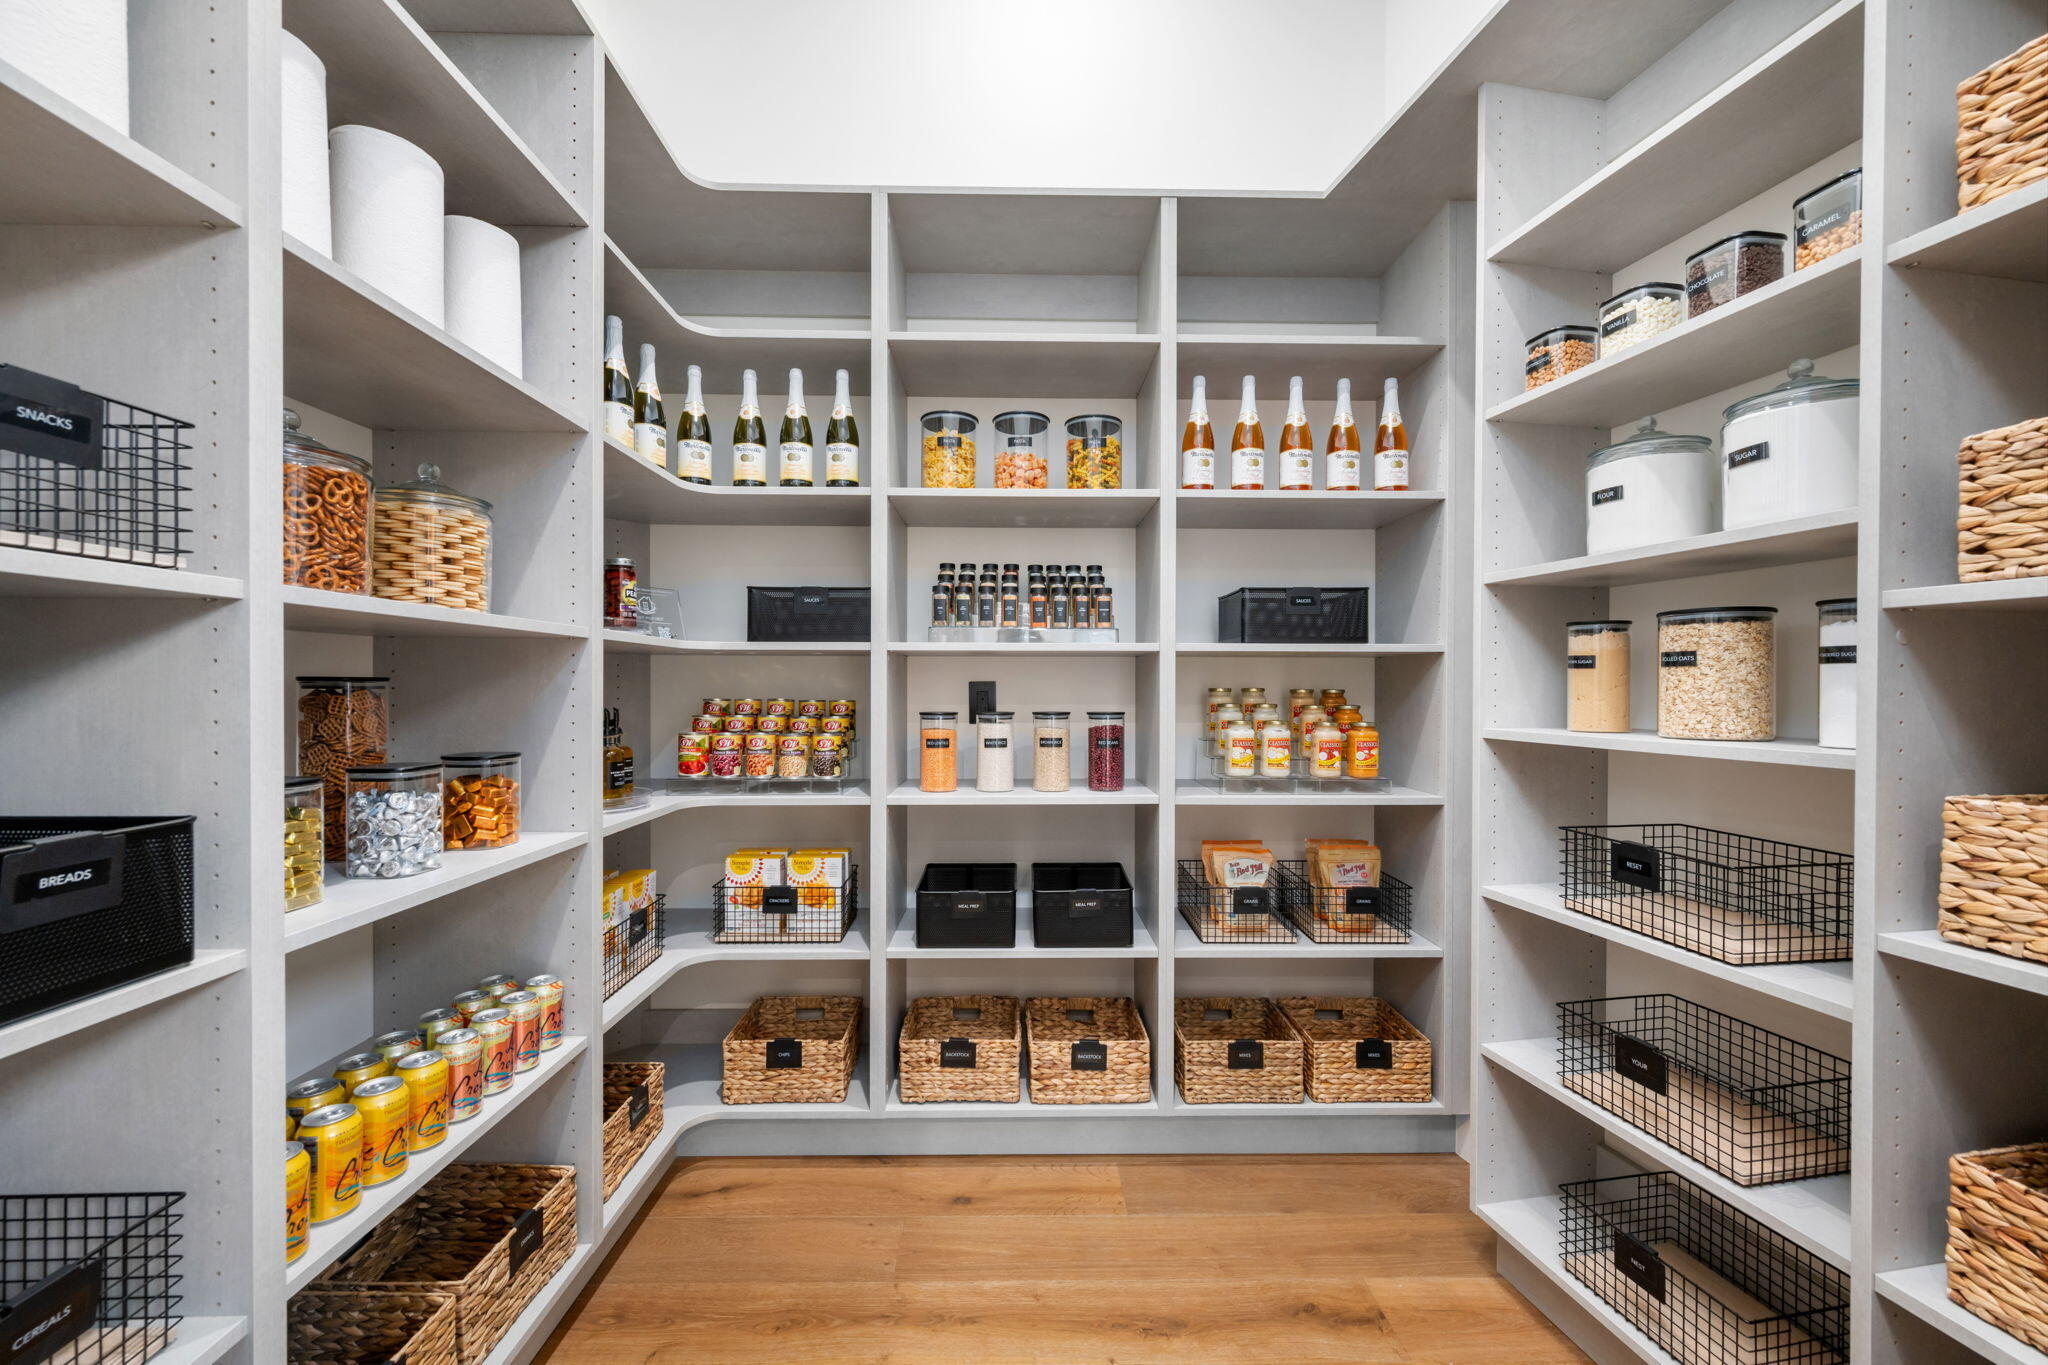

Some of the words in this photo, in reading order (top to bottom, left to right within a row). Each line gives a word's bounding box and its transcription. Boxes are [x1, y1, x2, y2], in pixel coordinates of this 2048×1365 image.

[1802, 212, 1841, 237] CARAMEL
[1688, 268, 1725, 292] CHOCOLATE
[1606, 315, 1630, 332] VANILLA
[16, 405, 73, 431] SNACKS
[1734, 449, 1757, 462] SUGAR
[1597, 491, 1615, 499] FLOUR
[1236, 865, 1249, 878] Red
[1342, 865, 1354, 876] Red
[1626, 861, 1642, 871] RESET
[38, 868, 93, 890] BREADS
[1631, 1057, 1648, 1070] YOUR
[11, 1303, 72, 1351] CEREALS
